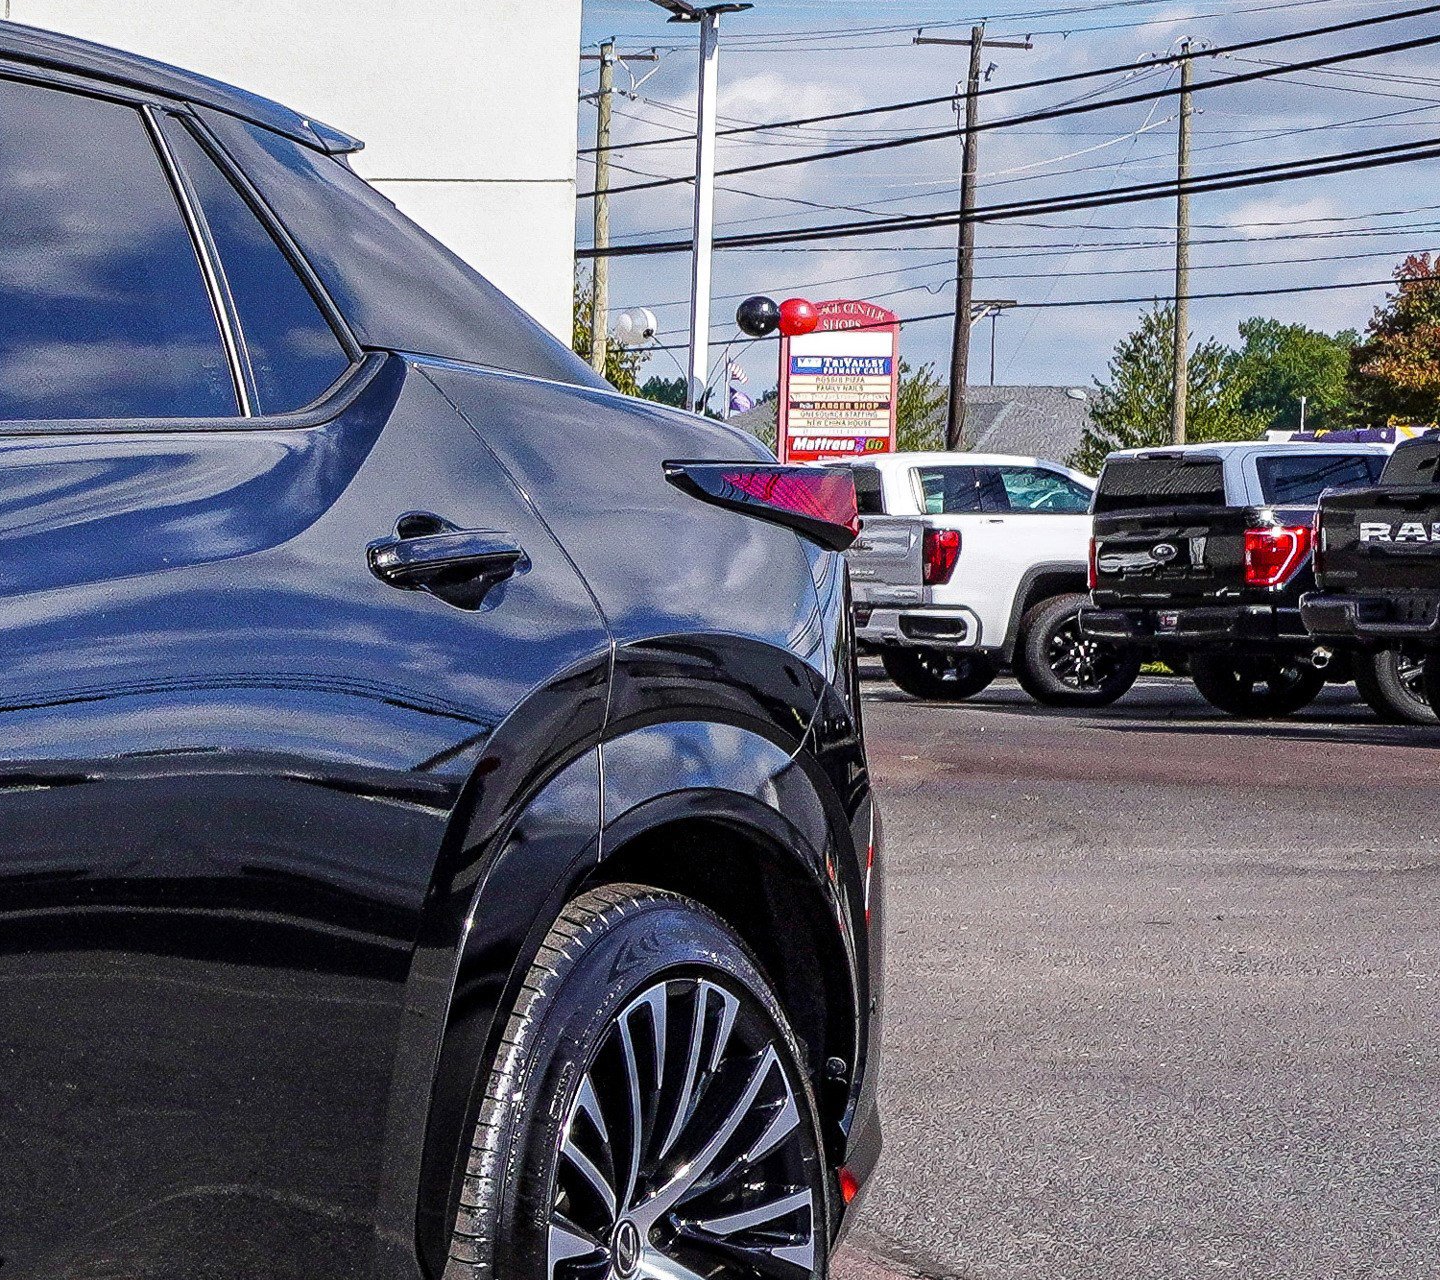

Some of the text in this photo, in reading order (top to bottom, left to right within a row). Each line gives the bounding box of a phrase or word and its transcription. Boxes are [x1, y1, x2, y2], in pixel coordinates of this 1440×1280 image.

[823, 320, 861, 330] SHOPS
[814, 402, 851, 410] BARBER
[853, 402, 879, 410] SHOP
[793, 437, 855, 451] Mattress
[1360, 522, 1440, 541] RA
